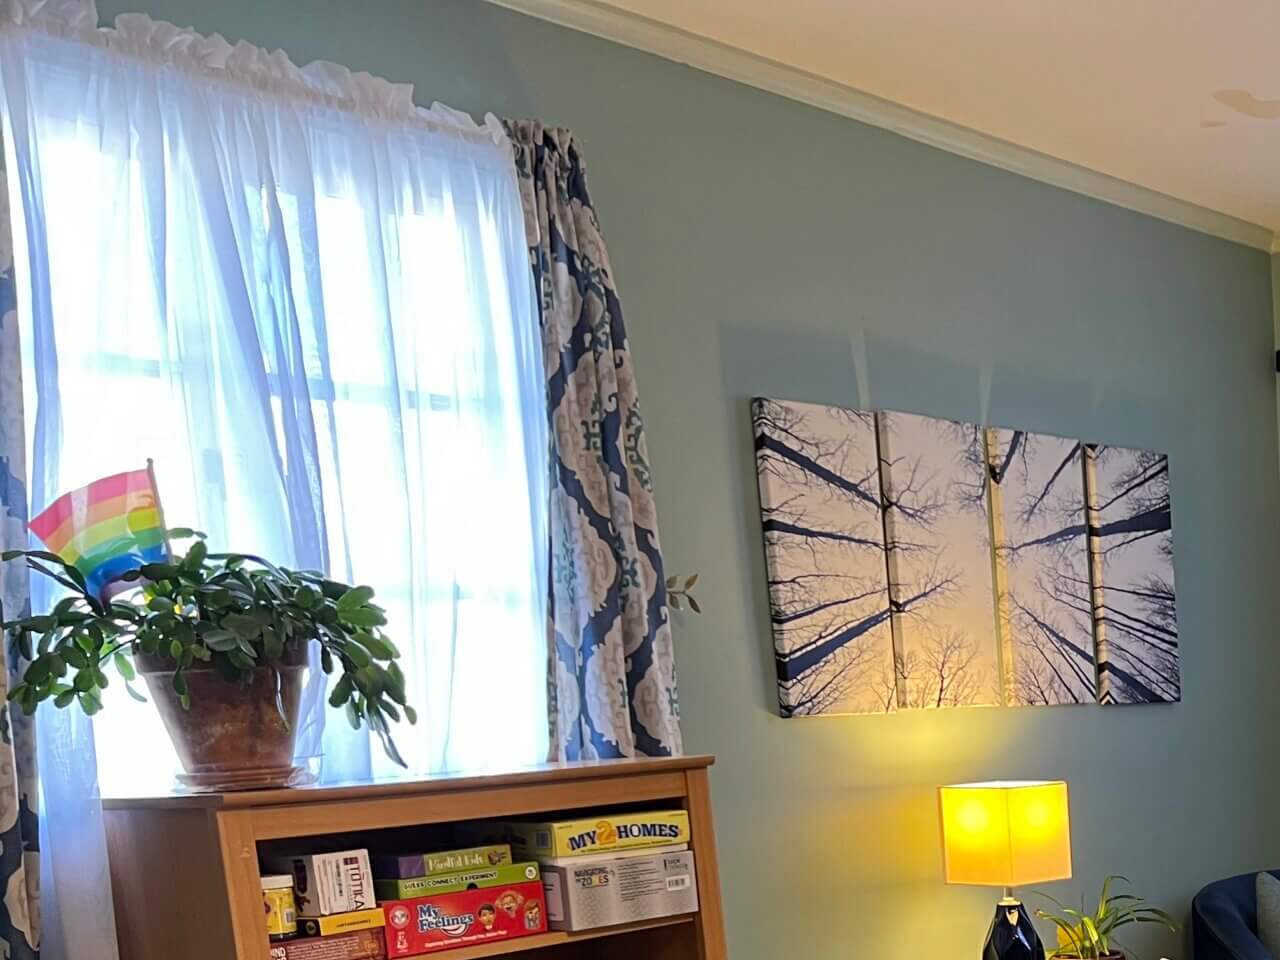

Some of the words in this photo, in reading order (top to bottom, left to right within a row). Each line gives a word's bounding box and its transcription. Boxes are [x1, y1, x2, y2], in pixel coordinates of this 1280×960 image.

[568, 830, 597, 851] MY
[595, 820, 617, 846] 2
[616, 823, 679, 840] HOMES
[427, 877, 458, 887] CONNECT
[460, 872, 497, 882] EXPERIMENT
[418, 904, 440, 922] My
[418, 914, 474, 933] Feelings
